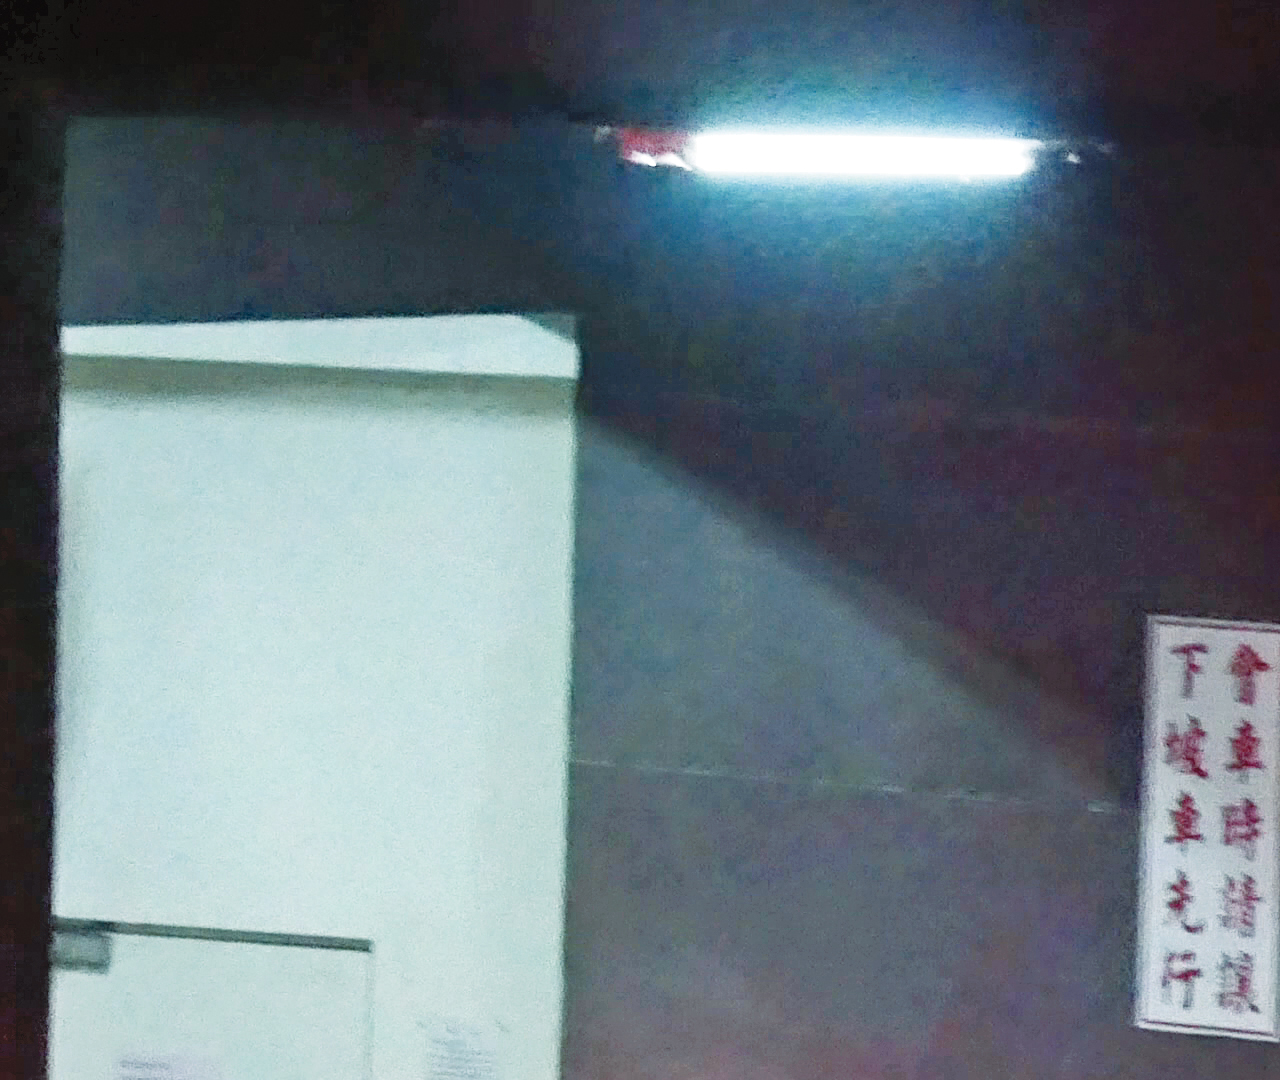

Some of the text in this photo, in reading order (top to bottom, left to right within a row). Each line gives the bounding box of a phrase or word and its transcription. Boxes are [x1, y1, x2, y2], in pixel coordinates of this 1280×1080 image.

[1160, 642, 1210, 1010] 下坡車先行
